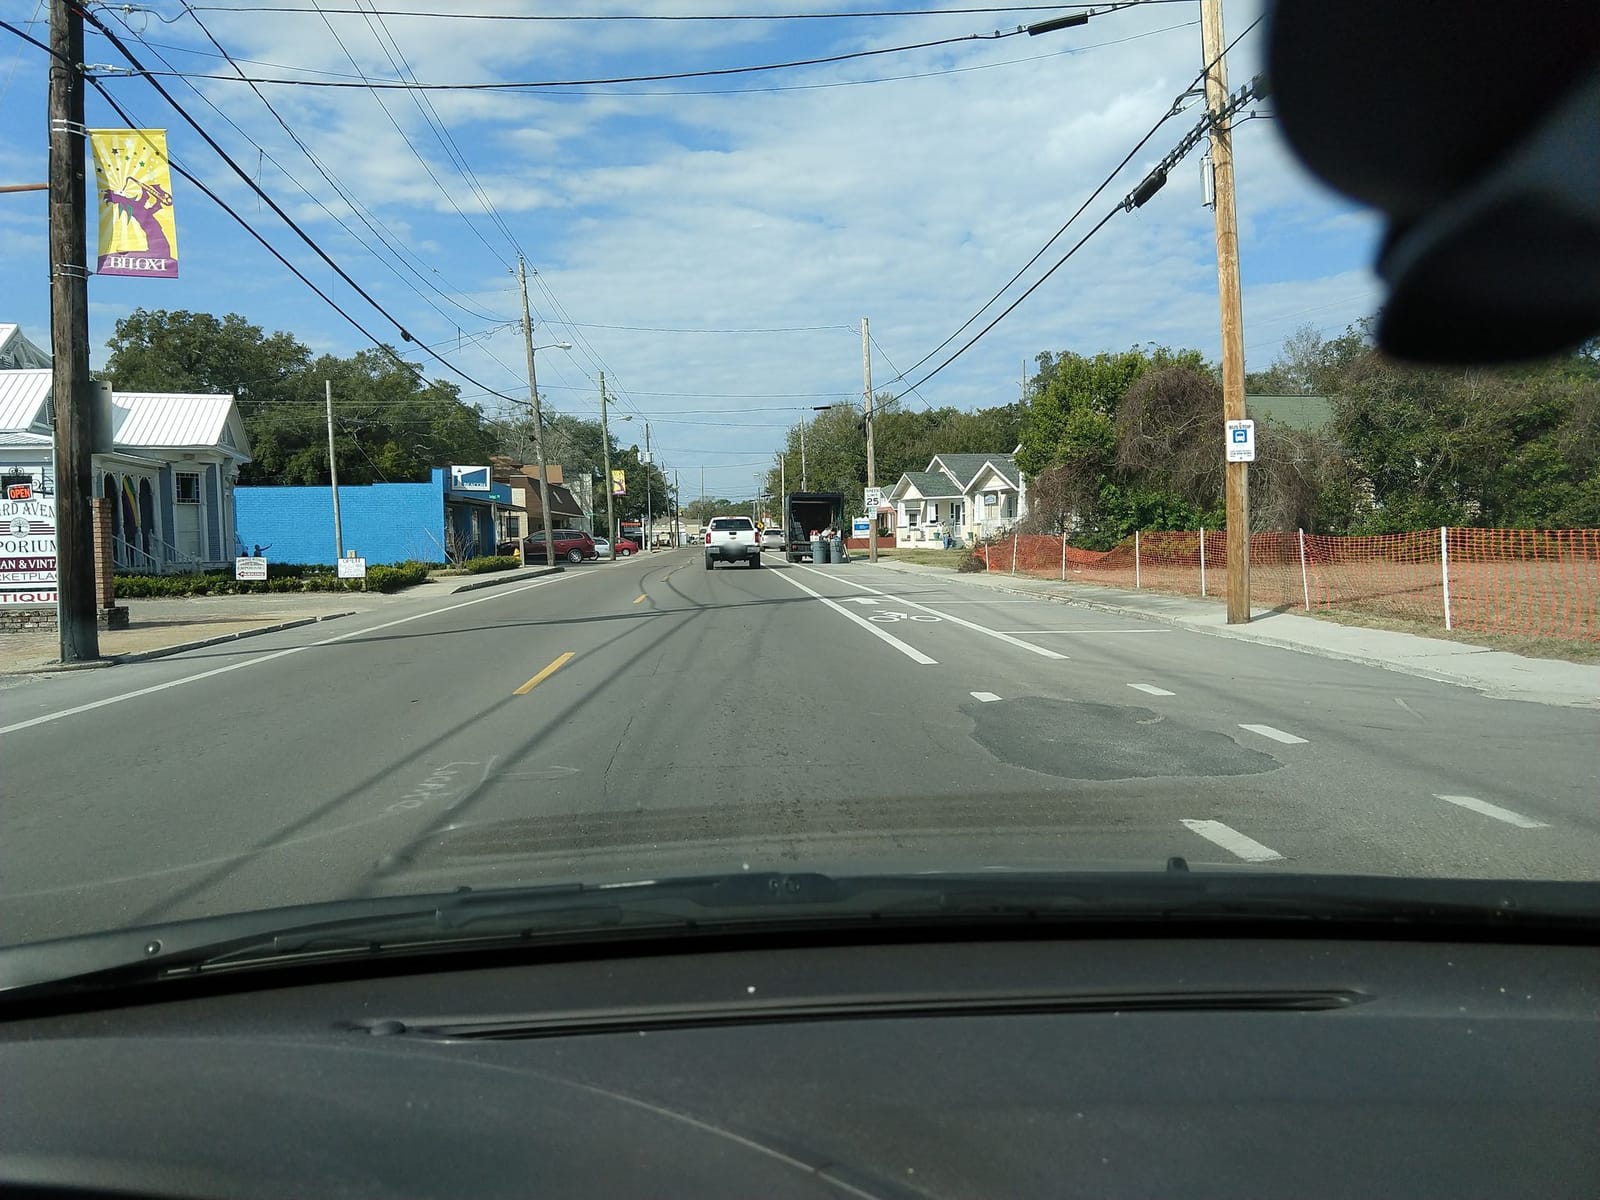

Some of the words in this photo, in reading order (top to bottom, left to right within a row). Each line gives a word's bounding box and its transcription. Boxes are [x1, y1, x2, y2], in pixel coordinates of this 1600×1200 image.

[110, 256, 167, 271] BILOXI
[10, 488, 30, 499] OPEN
[866, 498, 879, 506] 25
[0, 503, 18, 517] RD
[19, 559, 27, 569] &
[28, 559, 56, 569] VINT
[0, 572, 56, 581] KETPLA
